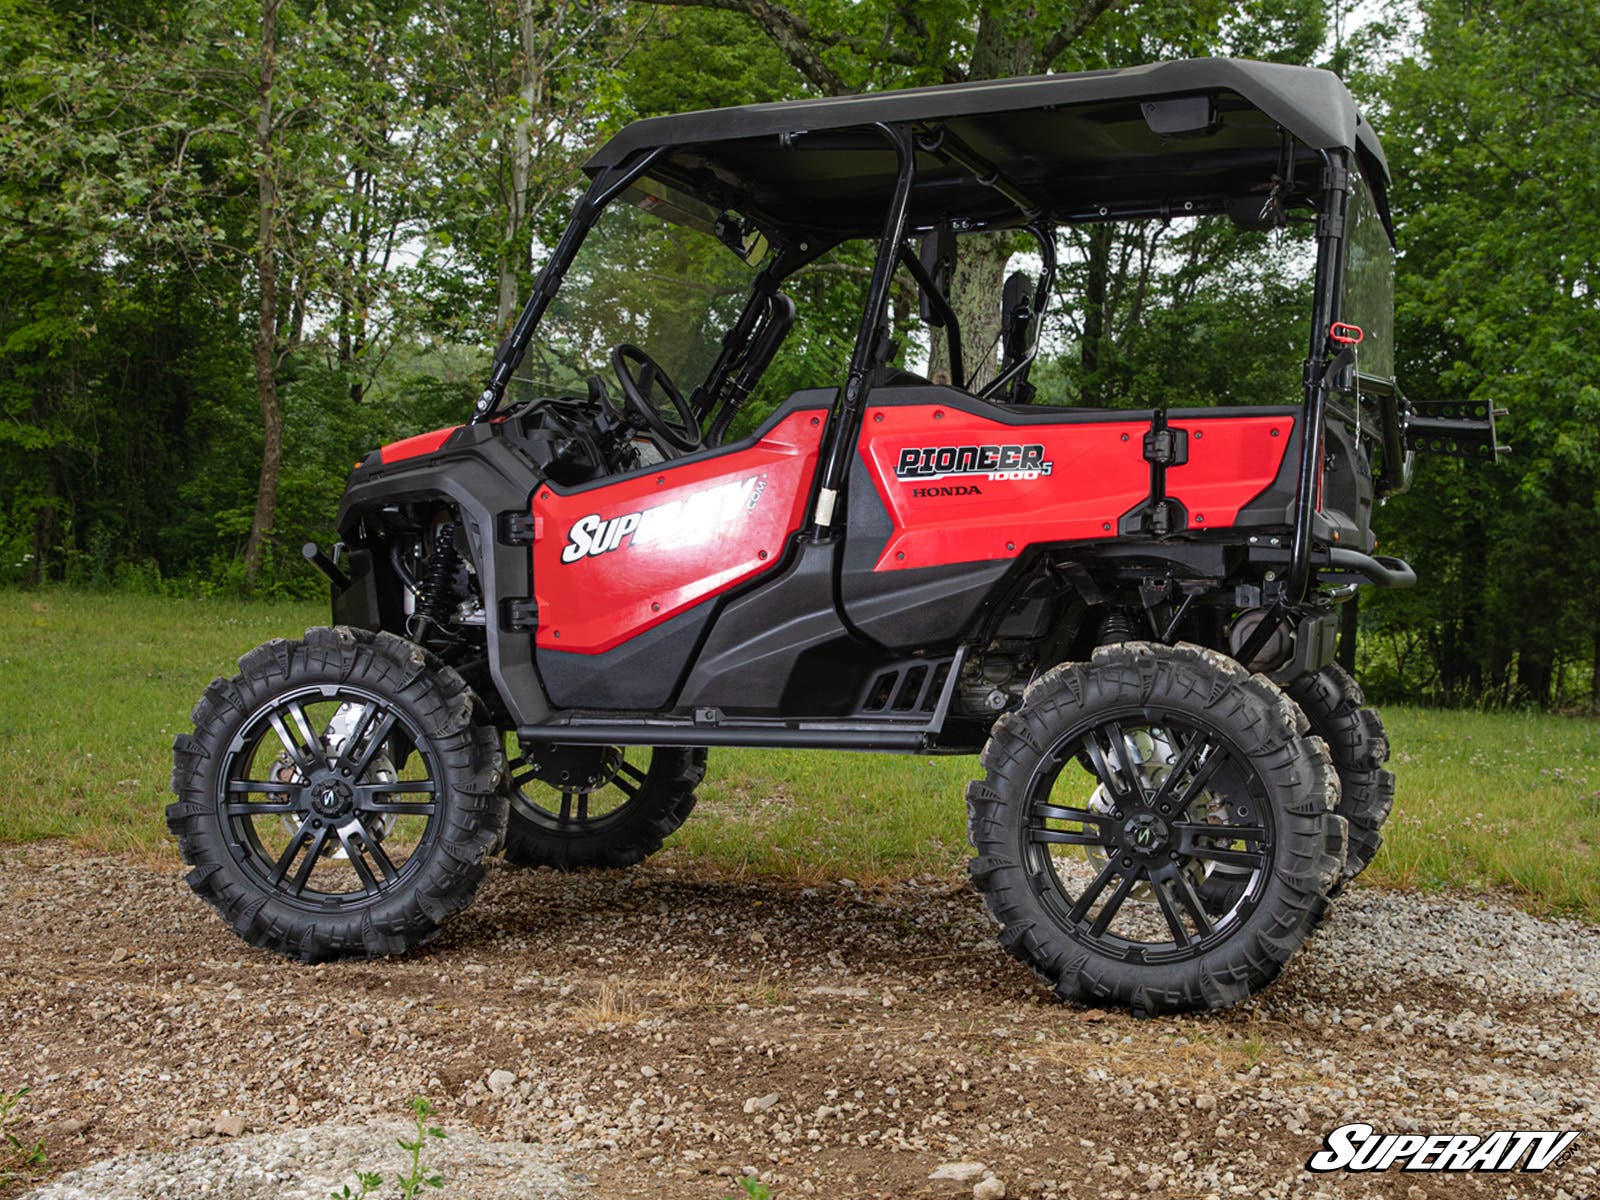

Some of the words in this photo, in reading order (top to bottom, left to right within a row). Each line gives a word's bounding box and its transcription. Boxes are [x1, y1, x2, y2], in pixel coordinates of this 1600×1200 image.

[898, 444, 1045, 474] PIONEER
[986, 470, 1042, 481] 1000
[913, 485, 982, 498] HONDA
